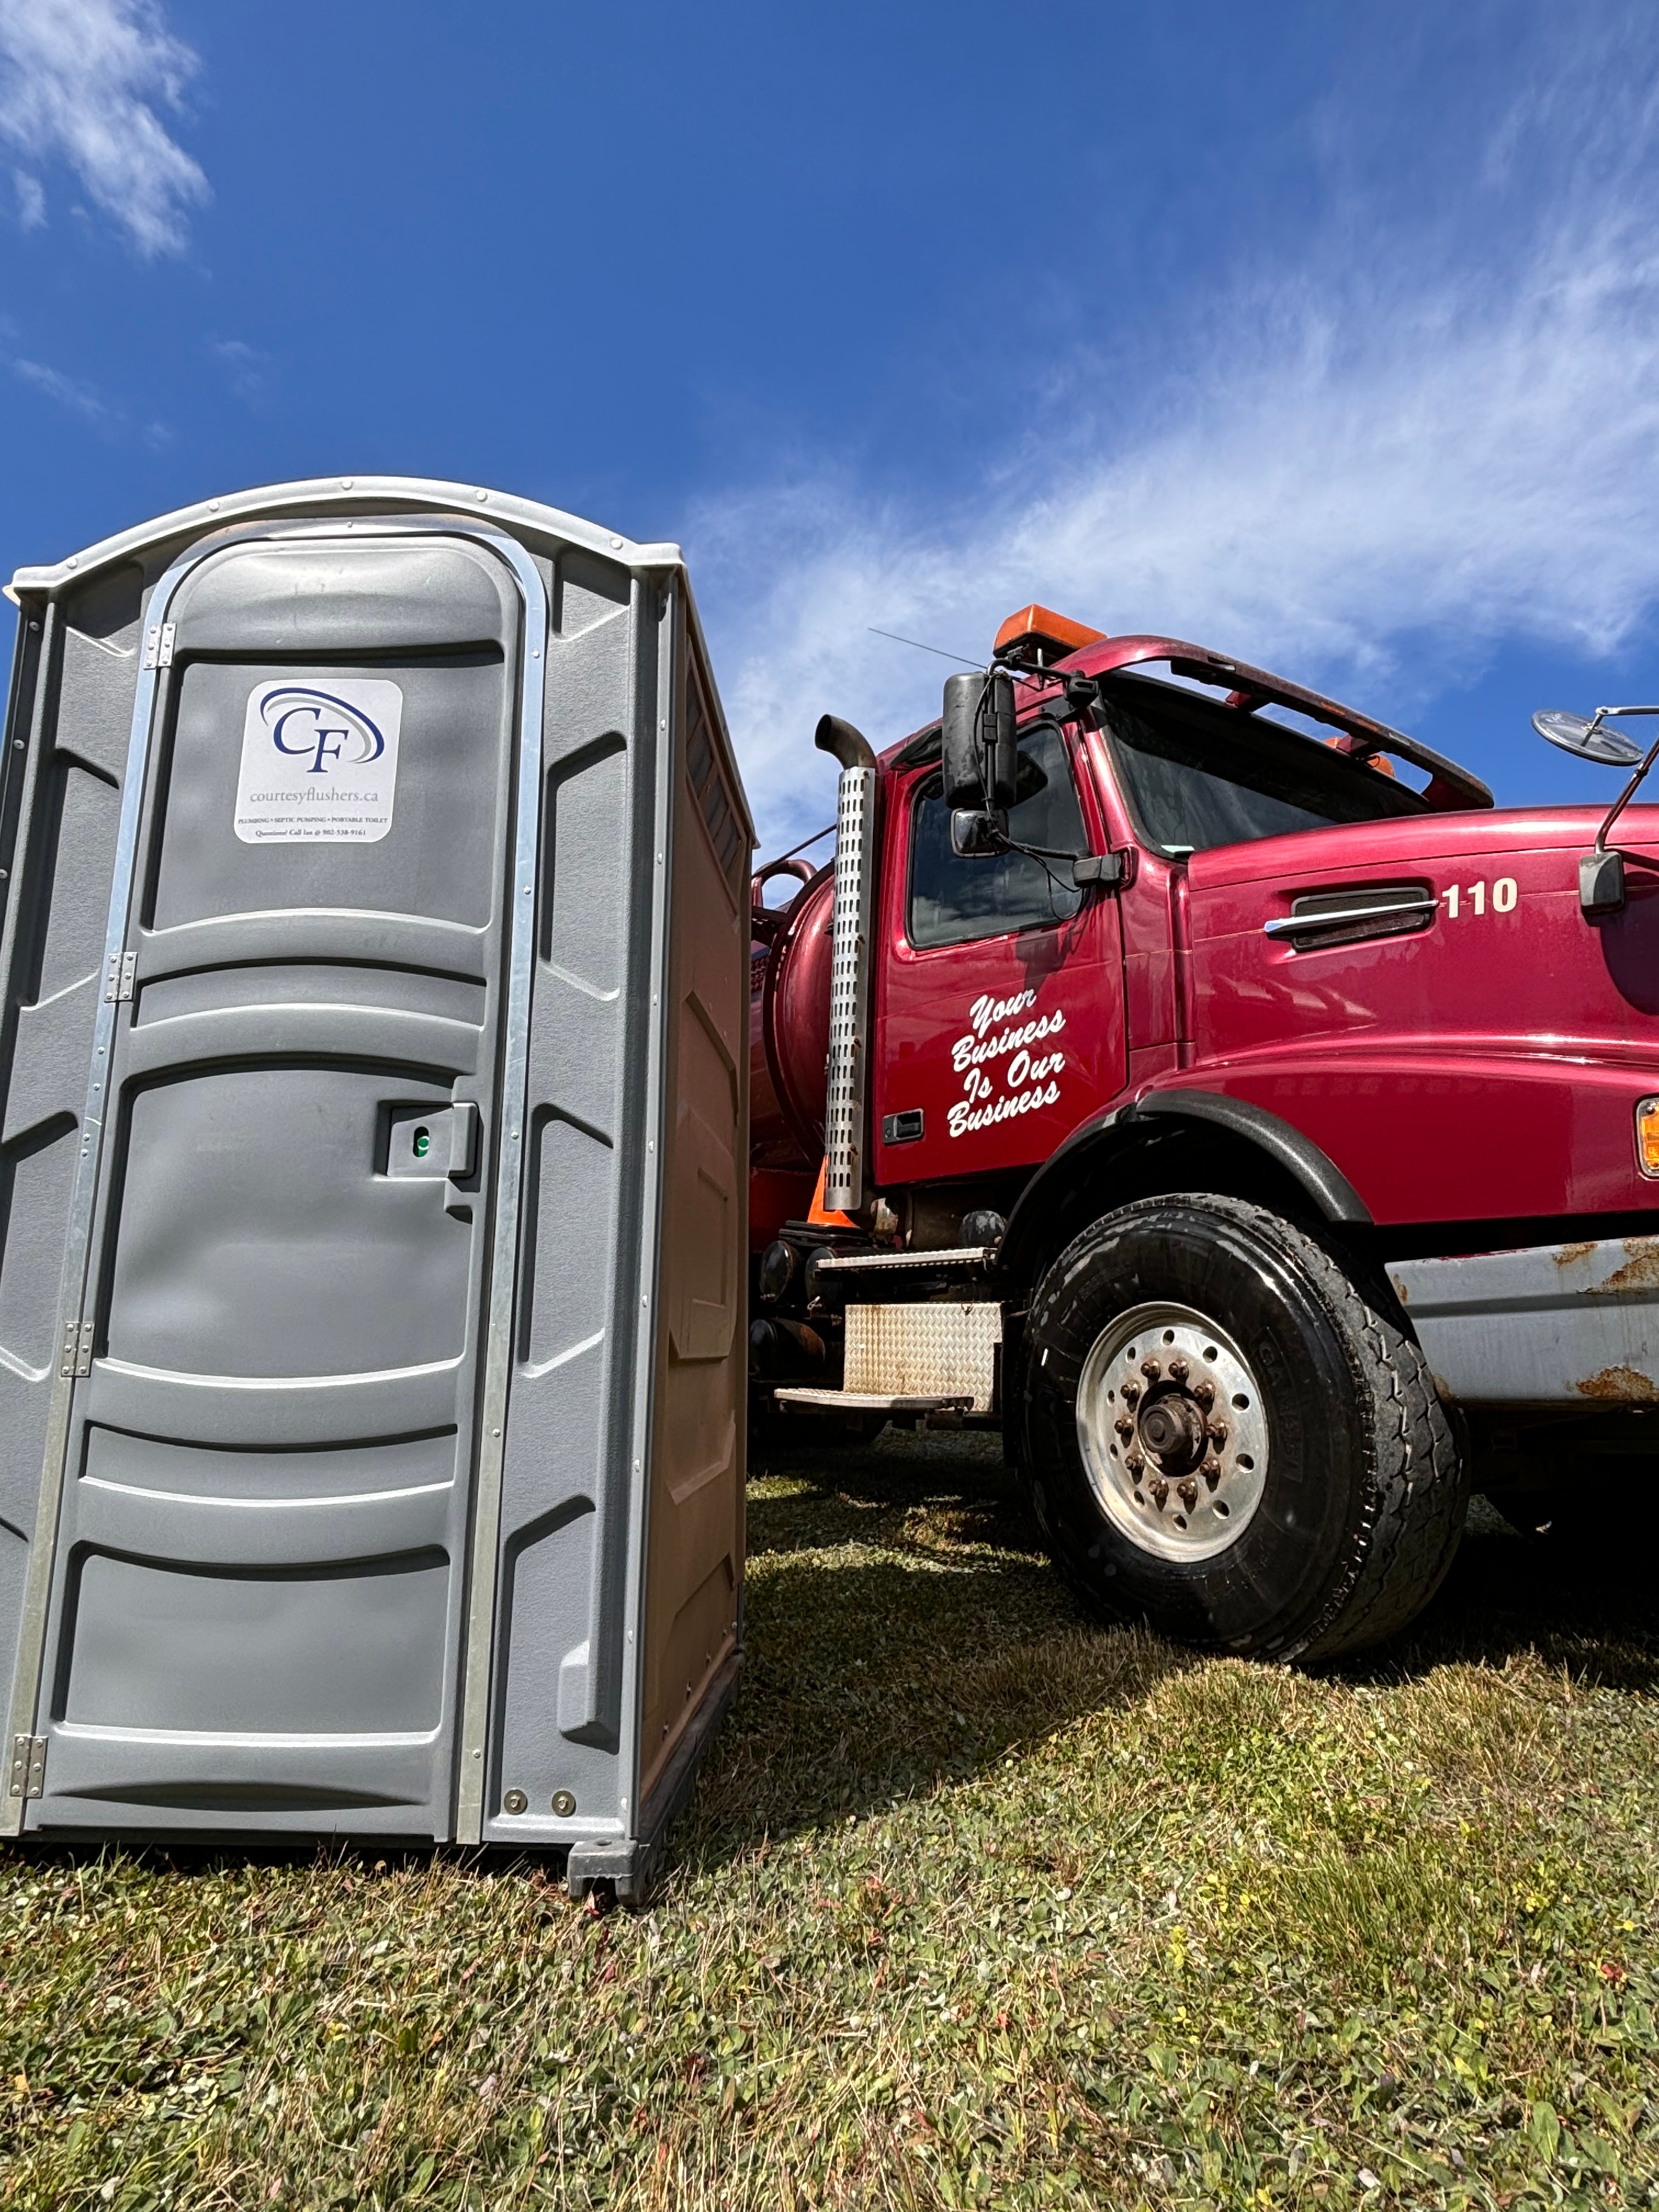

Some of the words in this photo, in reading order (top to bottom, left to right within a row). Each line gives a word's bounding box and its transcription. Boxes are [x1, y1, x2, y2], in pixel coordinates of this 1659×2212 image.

[273, 707, 349, 773] CF
[250, 787, 378, 805] courtesyflushers.ca
[1442, 877, 1517, 918] 110
[970, 988, 1037, 1039] Your
[951, 1009, 1066, 1072] Business
[963, 1068, 993, 1103] Is
[1007, 1050, 1065, 1087] Our
[947, 1080, 1062, 1138] Business
